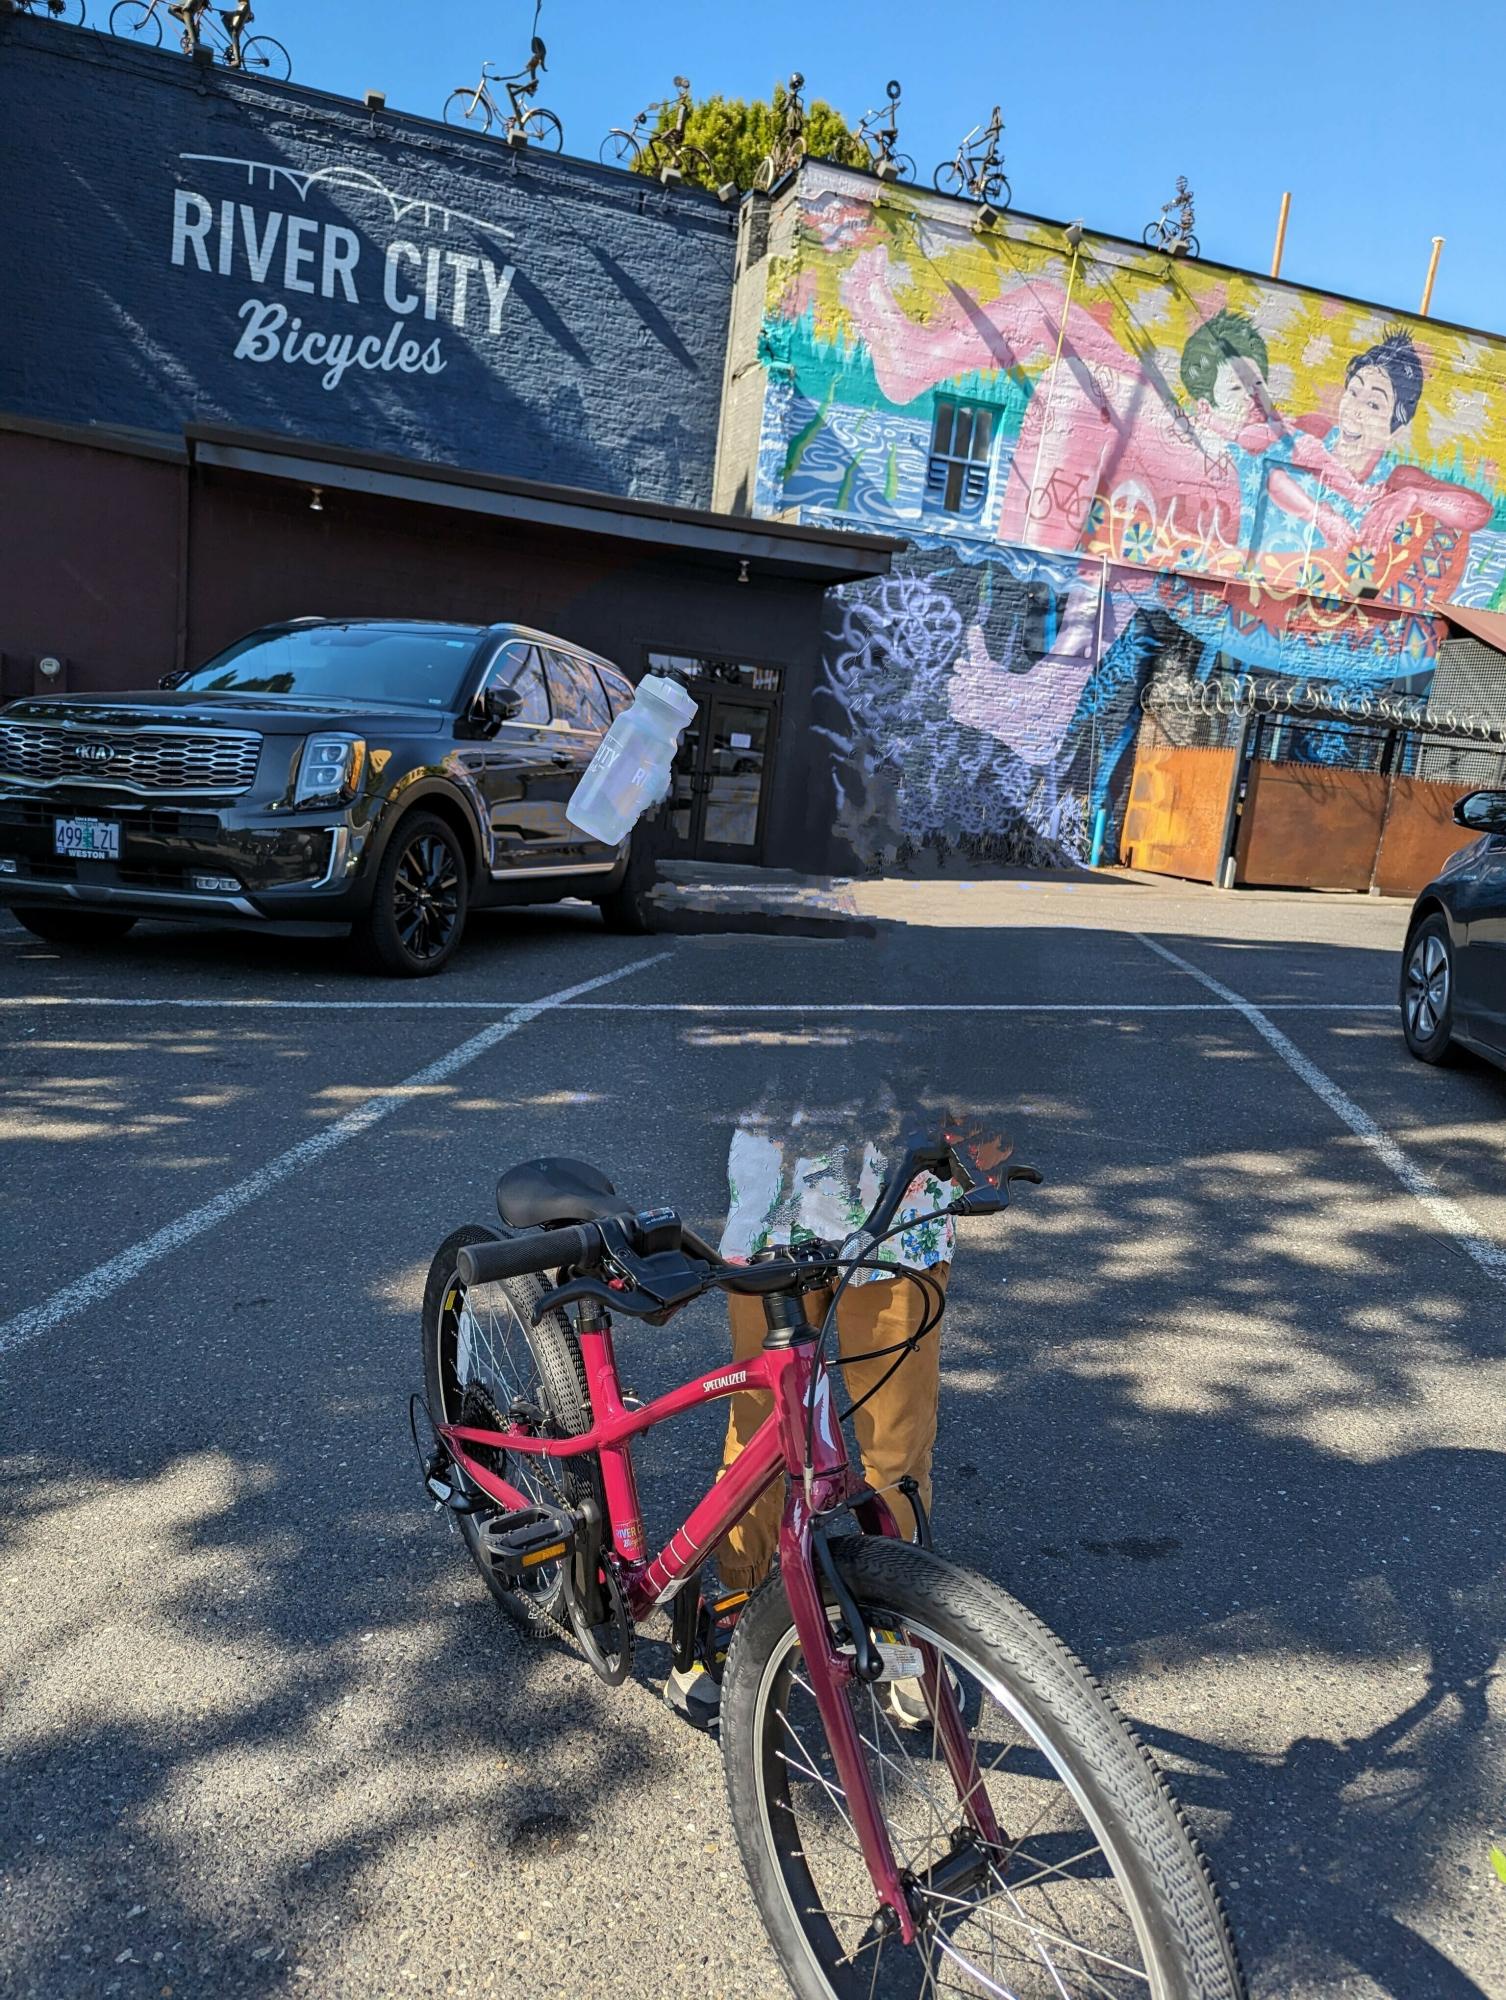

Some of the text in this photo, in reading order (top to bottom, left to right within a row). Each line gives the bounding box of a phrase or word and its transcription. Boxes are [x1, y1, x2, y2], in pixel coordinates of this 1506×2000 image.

[171, 189, 515, 334] RIVER CITY
[234, 299, 446, 390] Bicycles
[82, 746, 107, 760] KIA
[57, 826, 118, 850] 499 LZL
[68, 849, 105, 859] WESTON
[703, 1370, 747, 1392] SPECIALIZED
